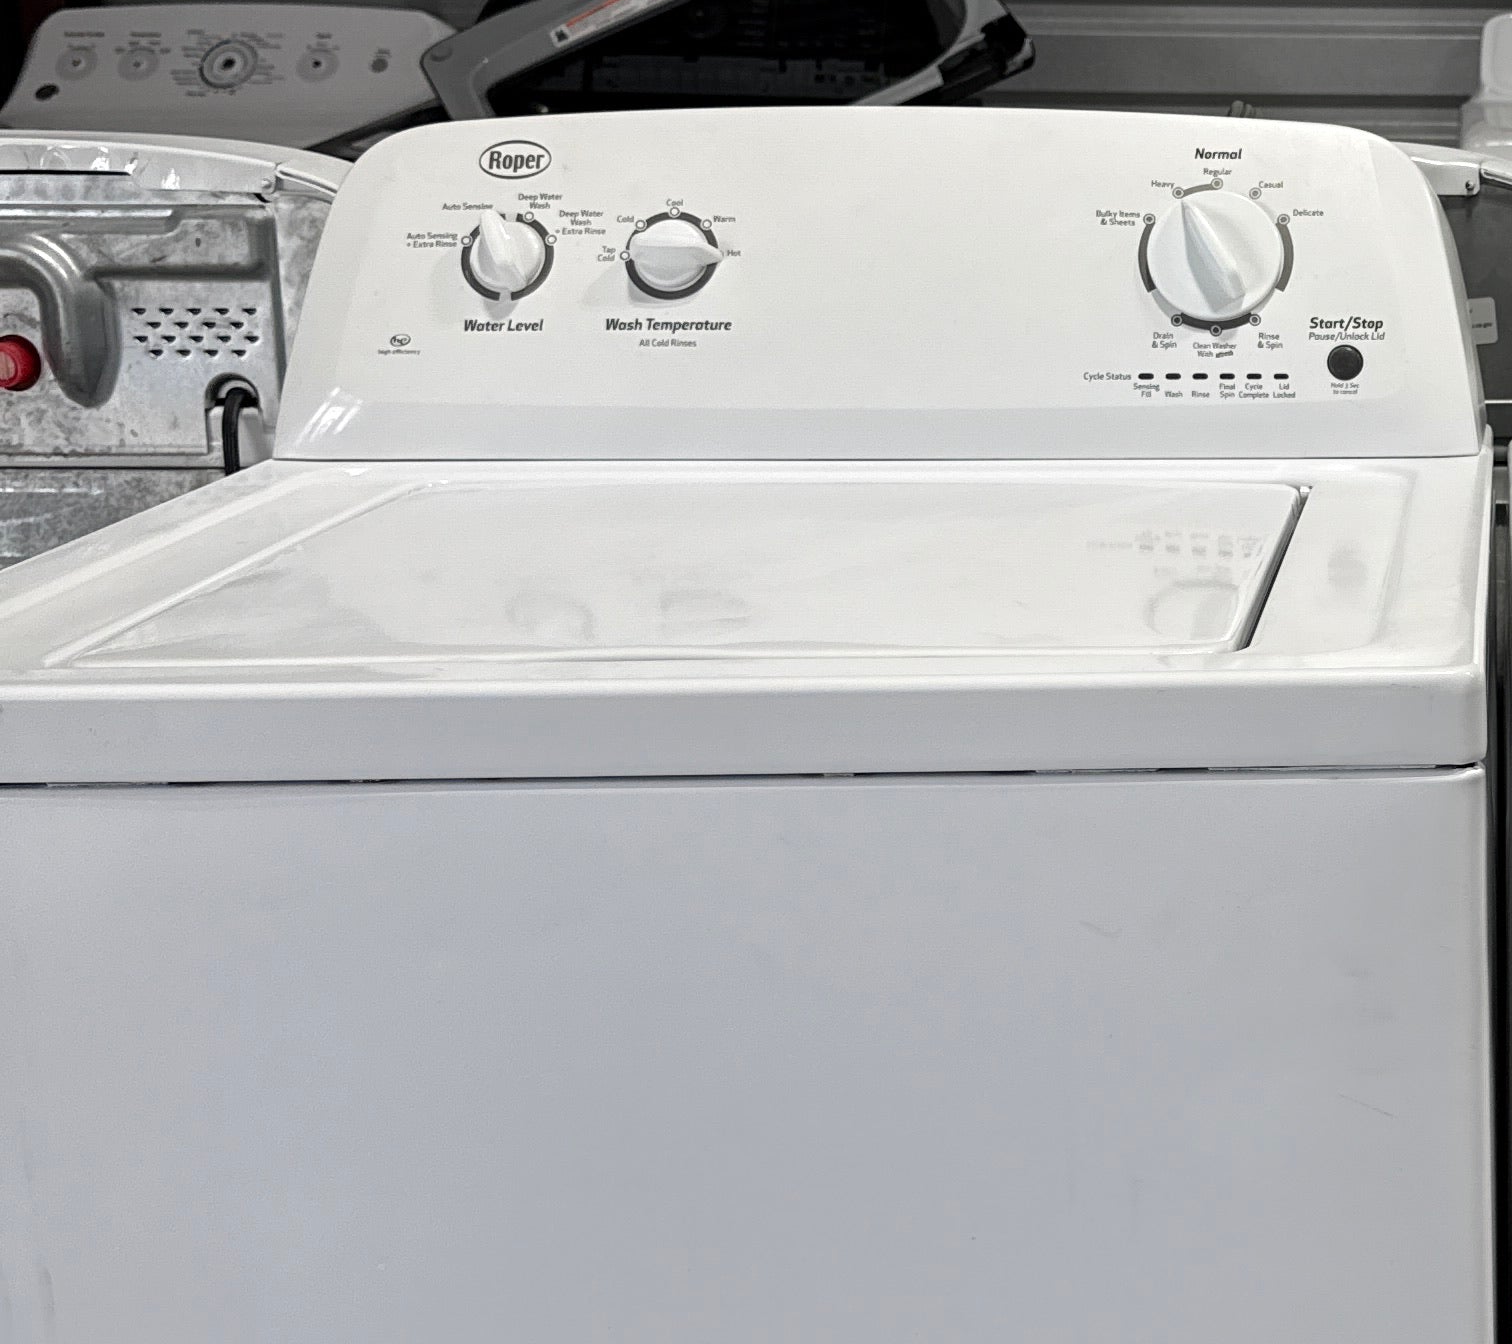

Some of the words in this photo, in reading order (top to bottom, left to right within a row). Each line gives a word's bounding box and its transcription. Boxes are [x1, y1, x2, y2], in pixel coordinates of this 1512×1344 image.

[1195, 148, 1242, 159] Normal
[489, 150, 545, 173] Roper
[1203, 168, 1232, 176] Regular
[1151, 180, 1175, 189] Heavy
[518, 193, 538, 202] Deep
[540, 193, 563, 201] Water
[442, 203, 461, 211] Auto
[559, 210, 579, 218] Deep
[1293, 209, 1324, 217] Delicate
[427, 233, 458, 241] Sensing
[602, 246, 615, 254] Tap
[464, 319, 504, 332] Water
[507, 319, 544, 332] Level
[606, 318, 642, 330] Wash
[646, 318, 732, 334] Temperature
[1309, 316, 1383, 332] Start/Stop
[1259, 332, 1279, 340] Rinse
[1309, 332, 1369, 342] Pause/Unlock
[1371, 332, 1385, 340] Lid
[671, 339, 696, 347] Rinses
[1160, 341, 1177, 350] Spin
[1266, 341, 1283, 350] Spin
[1083, 372, 1104, 381] Cycle
[1106, 372, 1131, 380] Status
[1134, 383, 1160, 392] Sensing
[1245, 383, 1263, 391] Cycle
[1220, 391, 1235, 399] Spin
[1239, 391, 1269, 399] Complete
